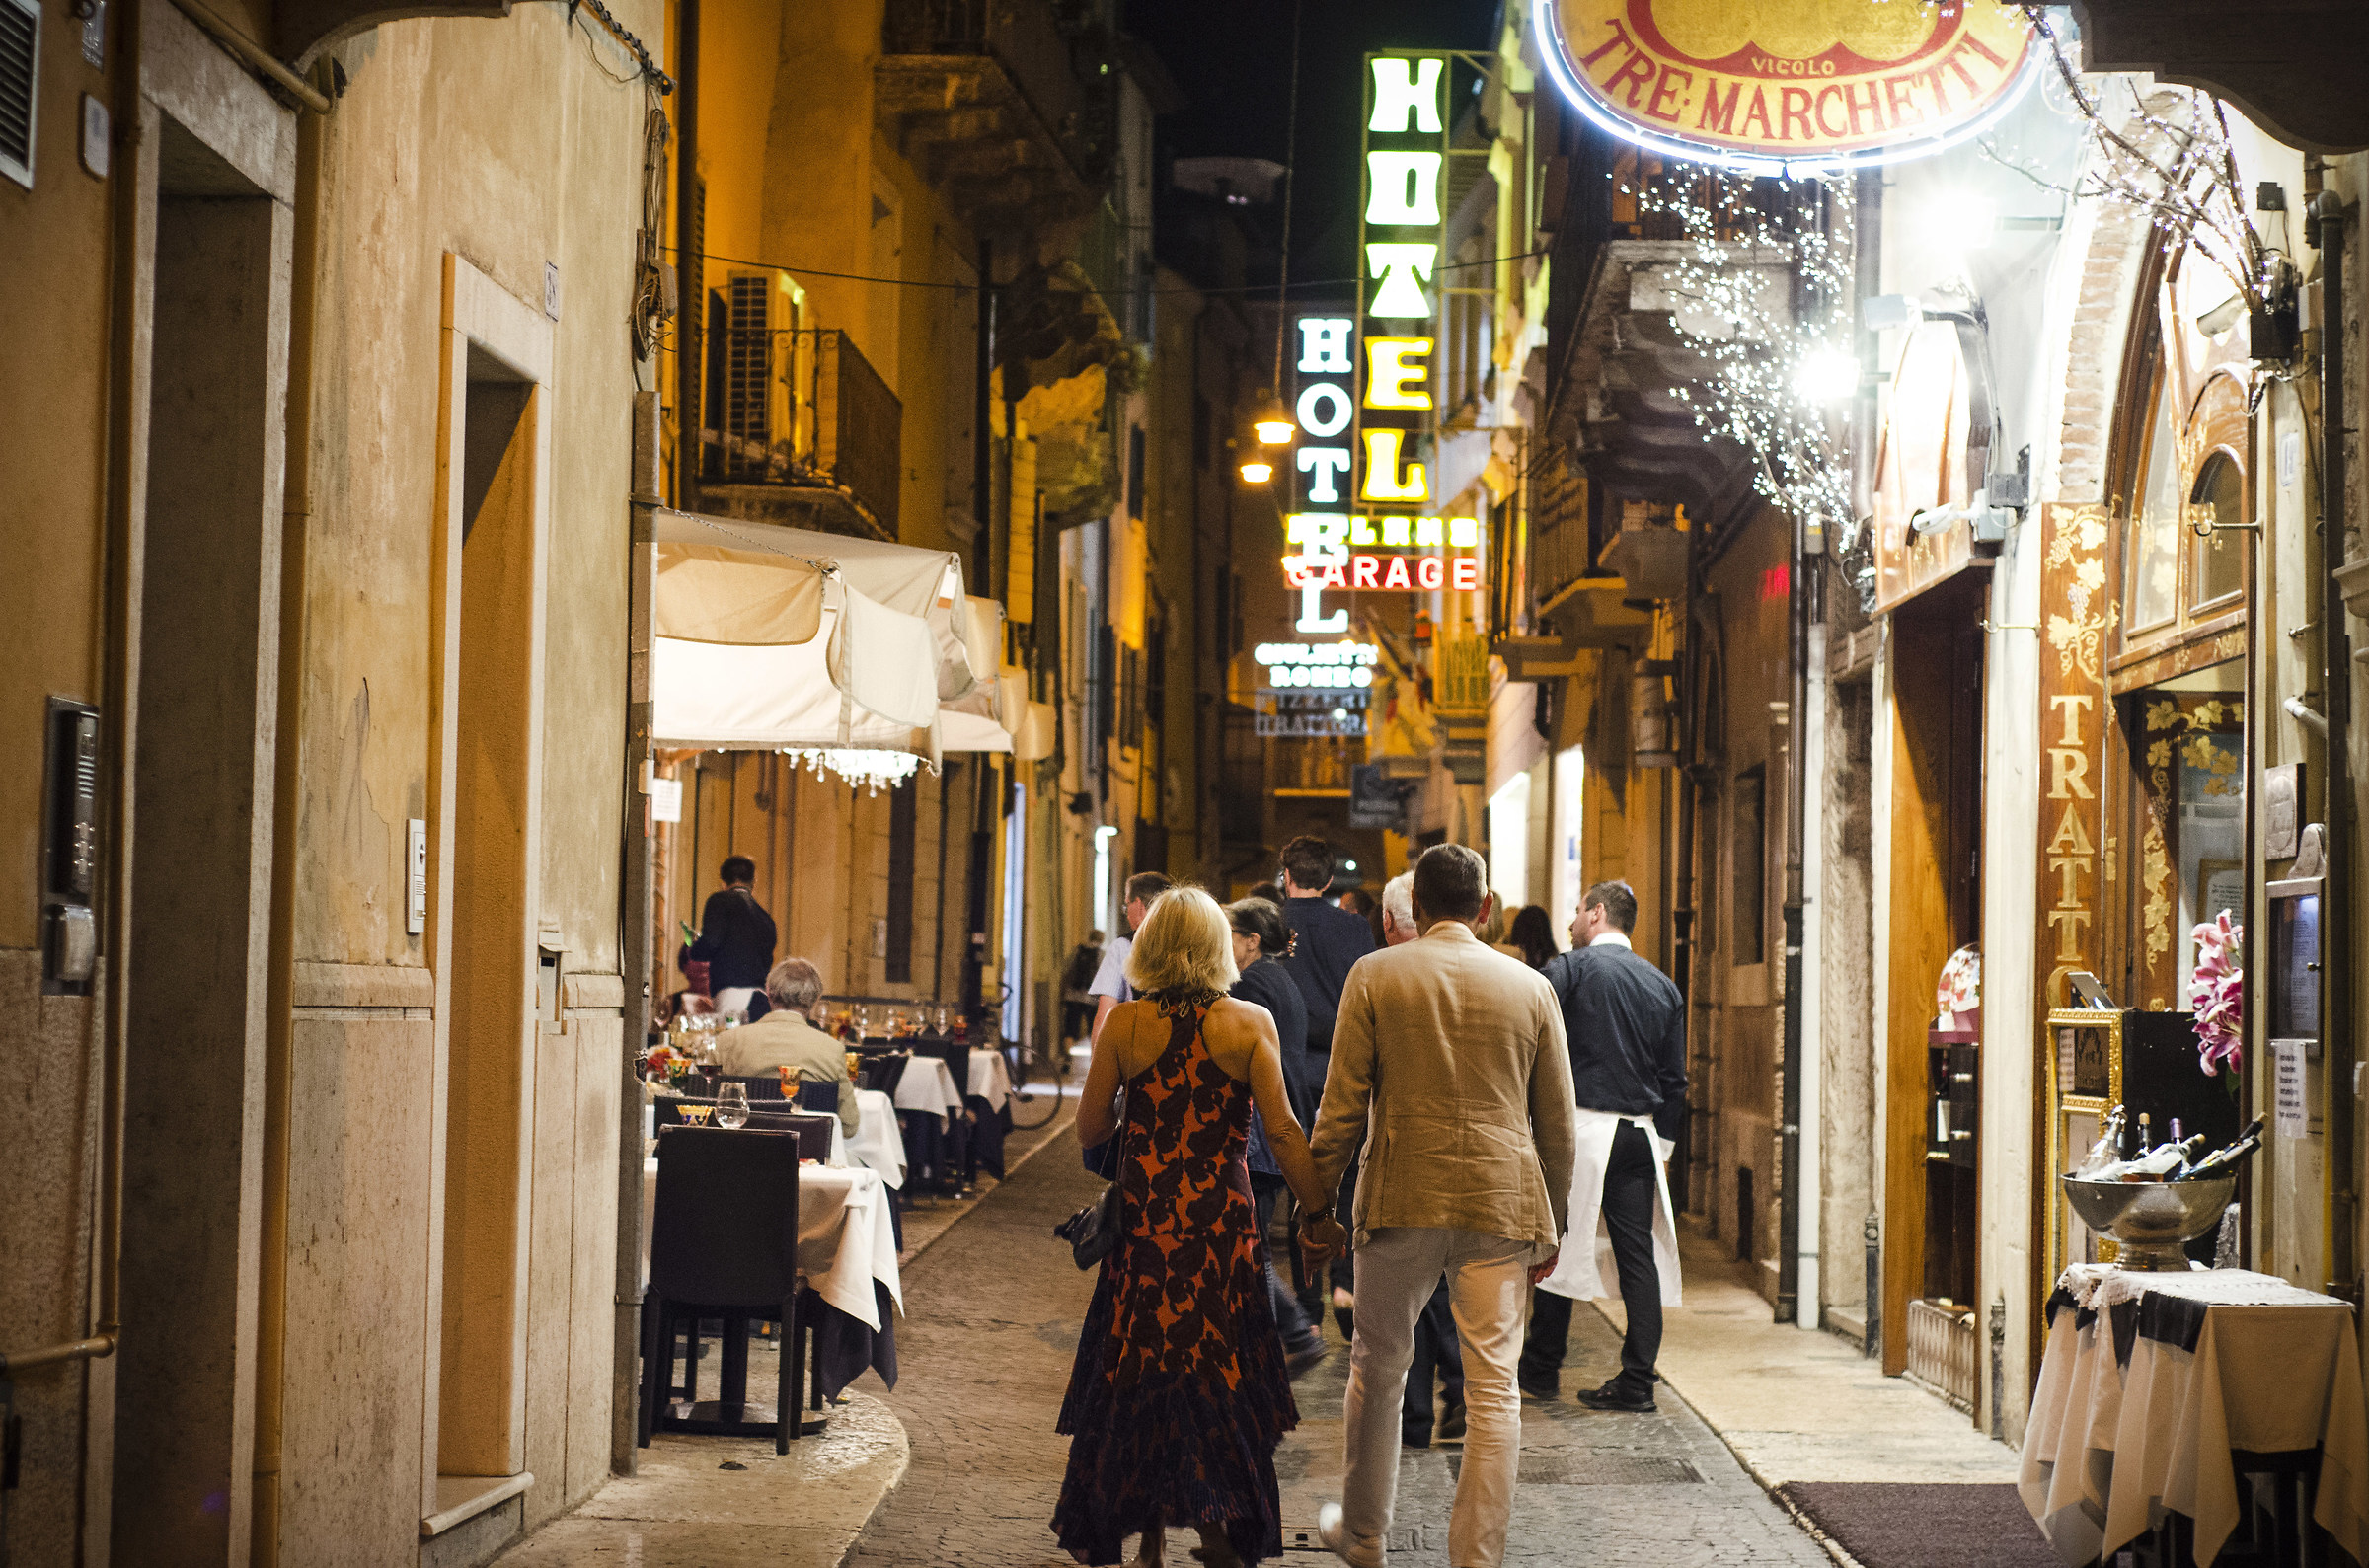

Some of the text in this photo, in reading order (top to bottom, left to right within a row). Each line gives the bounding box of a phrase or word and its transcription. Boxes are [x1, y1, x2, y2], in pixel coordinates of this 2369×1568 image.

[1695, 30, 2010, 141] MARCHETTI
[1751, 57, 1836, 76] VICOLO
[1361, 57, 1444, 502] HOTEL
[1296, 318, 1353, 633] HOTEL
[1287, 555, 1478, 590] GARAGE
